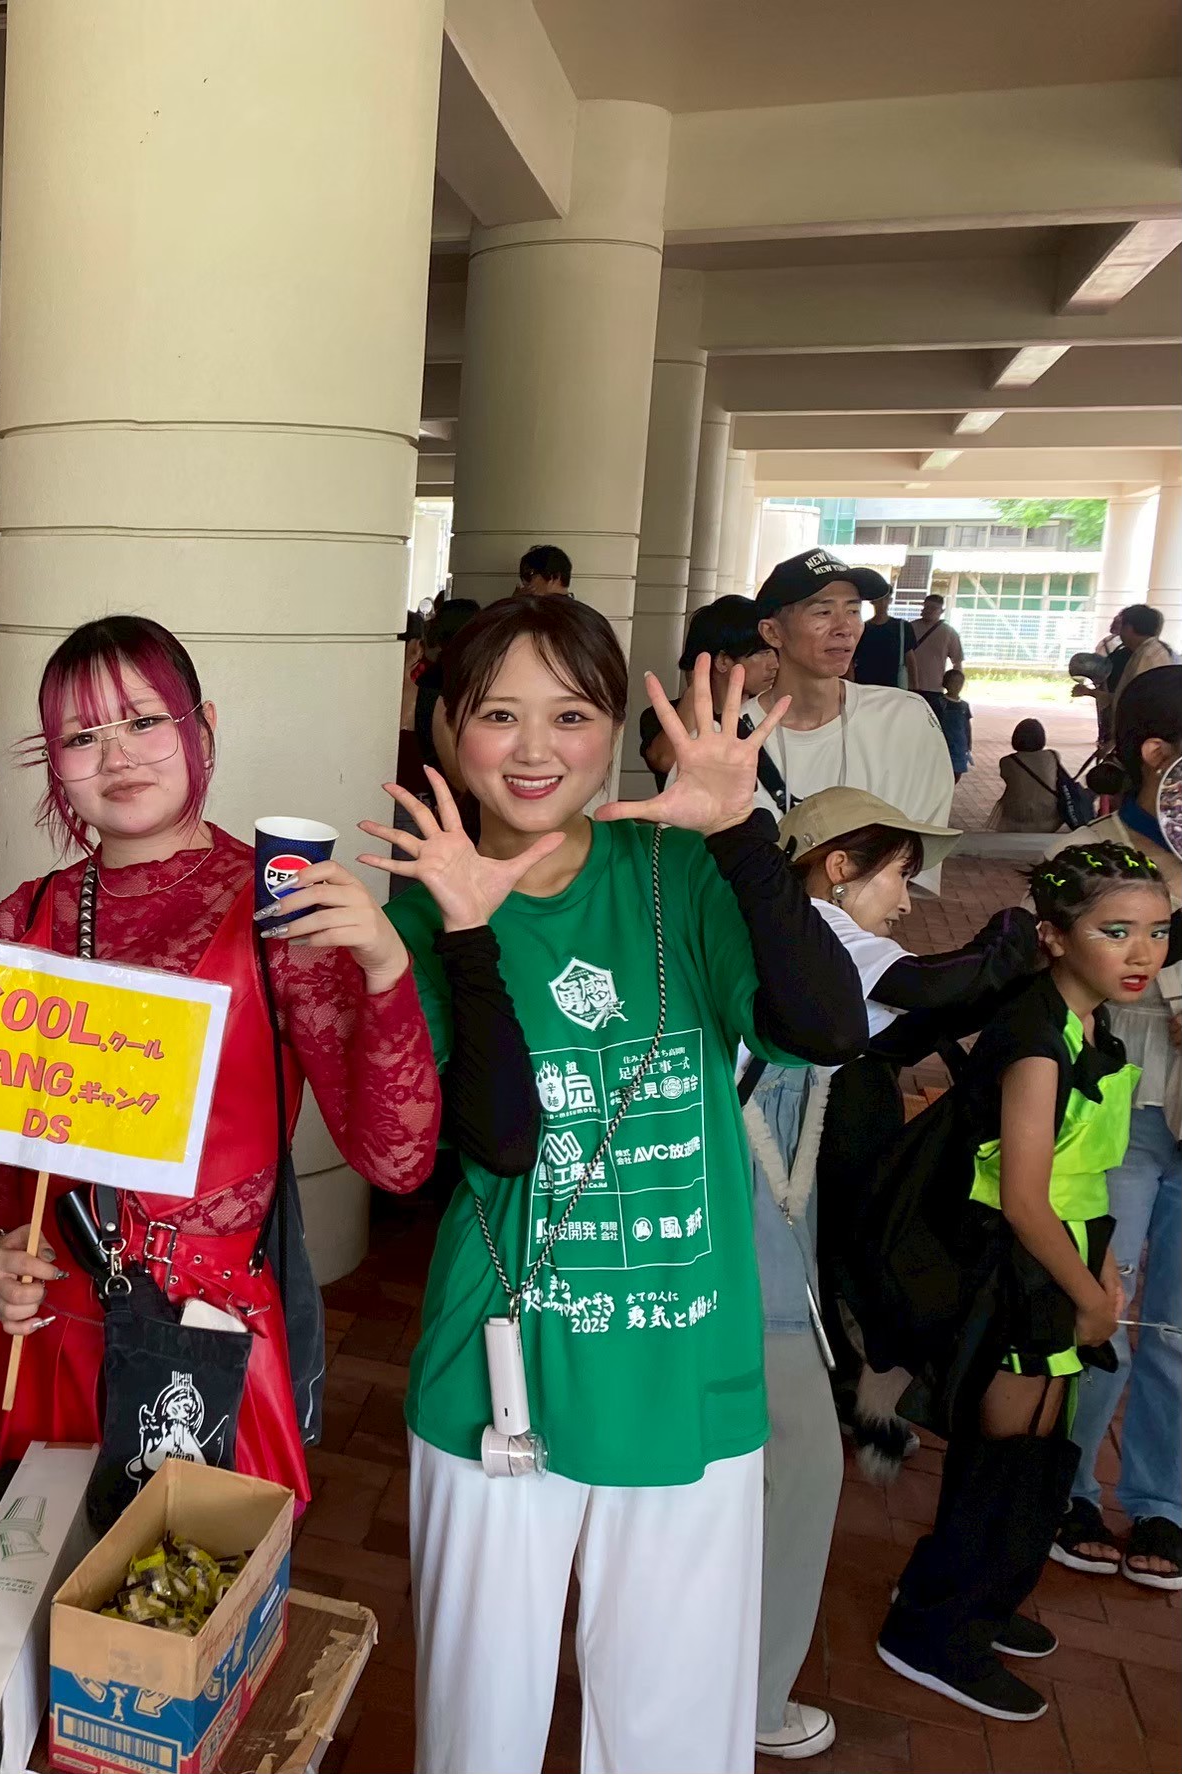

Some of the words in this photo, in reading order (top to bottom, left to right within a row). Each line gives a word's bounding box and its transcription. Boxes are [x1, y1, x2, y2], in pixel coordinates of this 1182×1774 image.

[108, 1031, 165, 1060] クール
[78, 1081, 160, 1115] ギャング
[21, 1108, 73, 1144] DS
[571, 1317, 610, 1334] 2025
